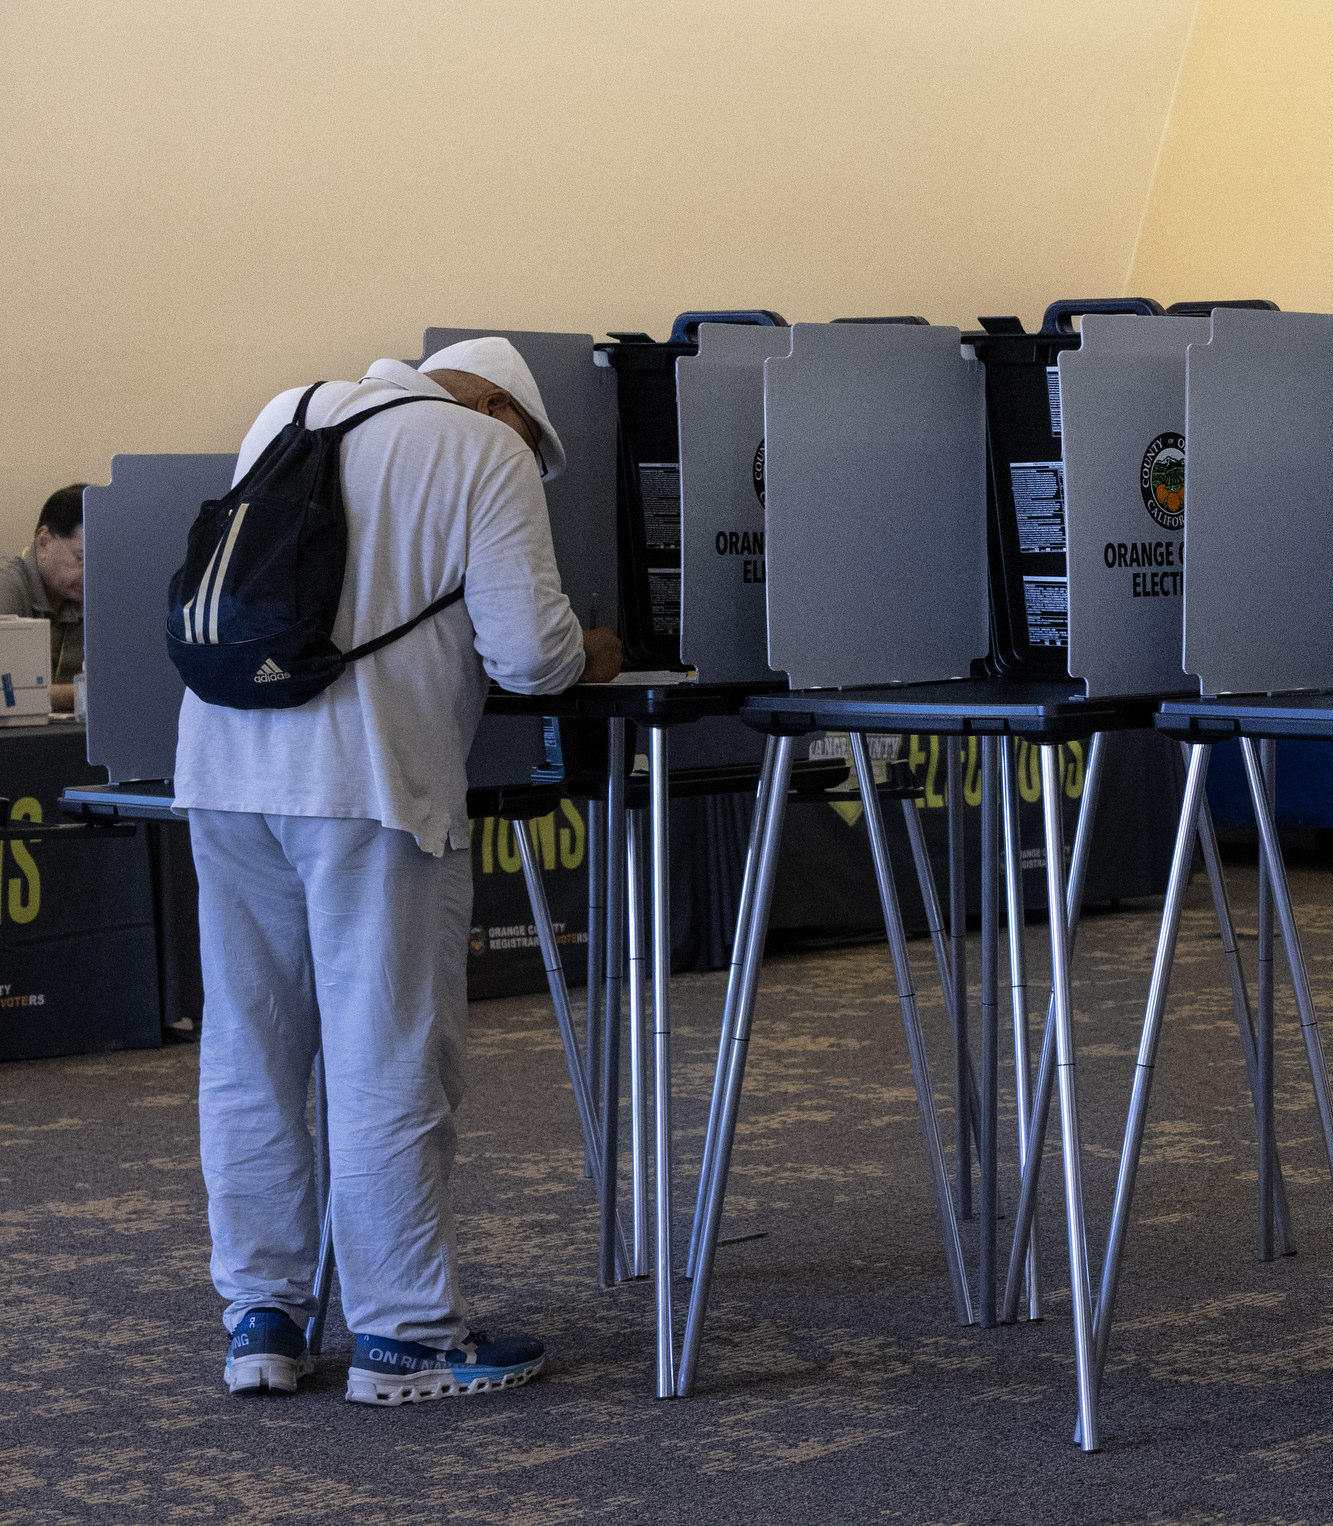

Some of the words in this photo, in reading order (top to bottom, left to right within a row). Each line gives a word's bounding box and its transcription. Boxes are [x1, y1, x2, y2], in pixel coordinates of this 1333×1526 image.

[1142, 437, 1163, 488] COUNTY
[1147, 499, 1185, 527] CALIFOR
[715, 530, 764, 556] ORAN
[1103, 541, 1174, 569] ORANGE
[1132, 571, 1184, 598] ELECTI
[254, 672, 291, 683] adidas
[488, 925, 526, 939] ORANGE
[0, 993, 46, 1008] VOTERS
